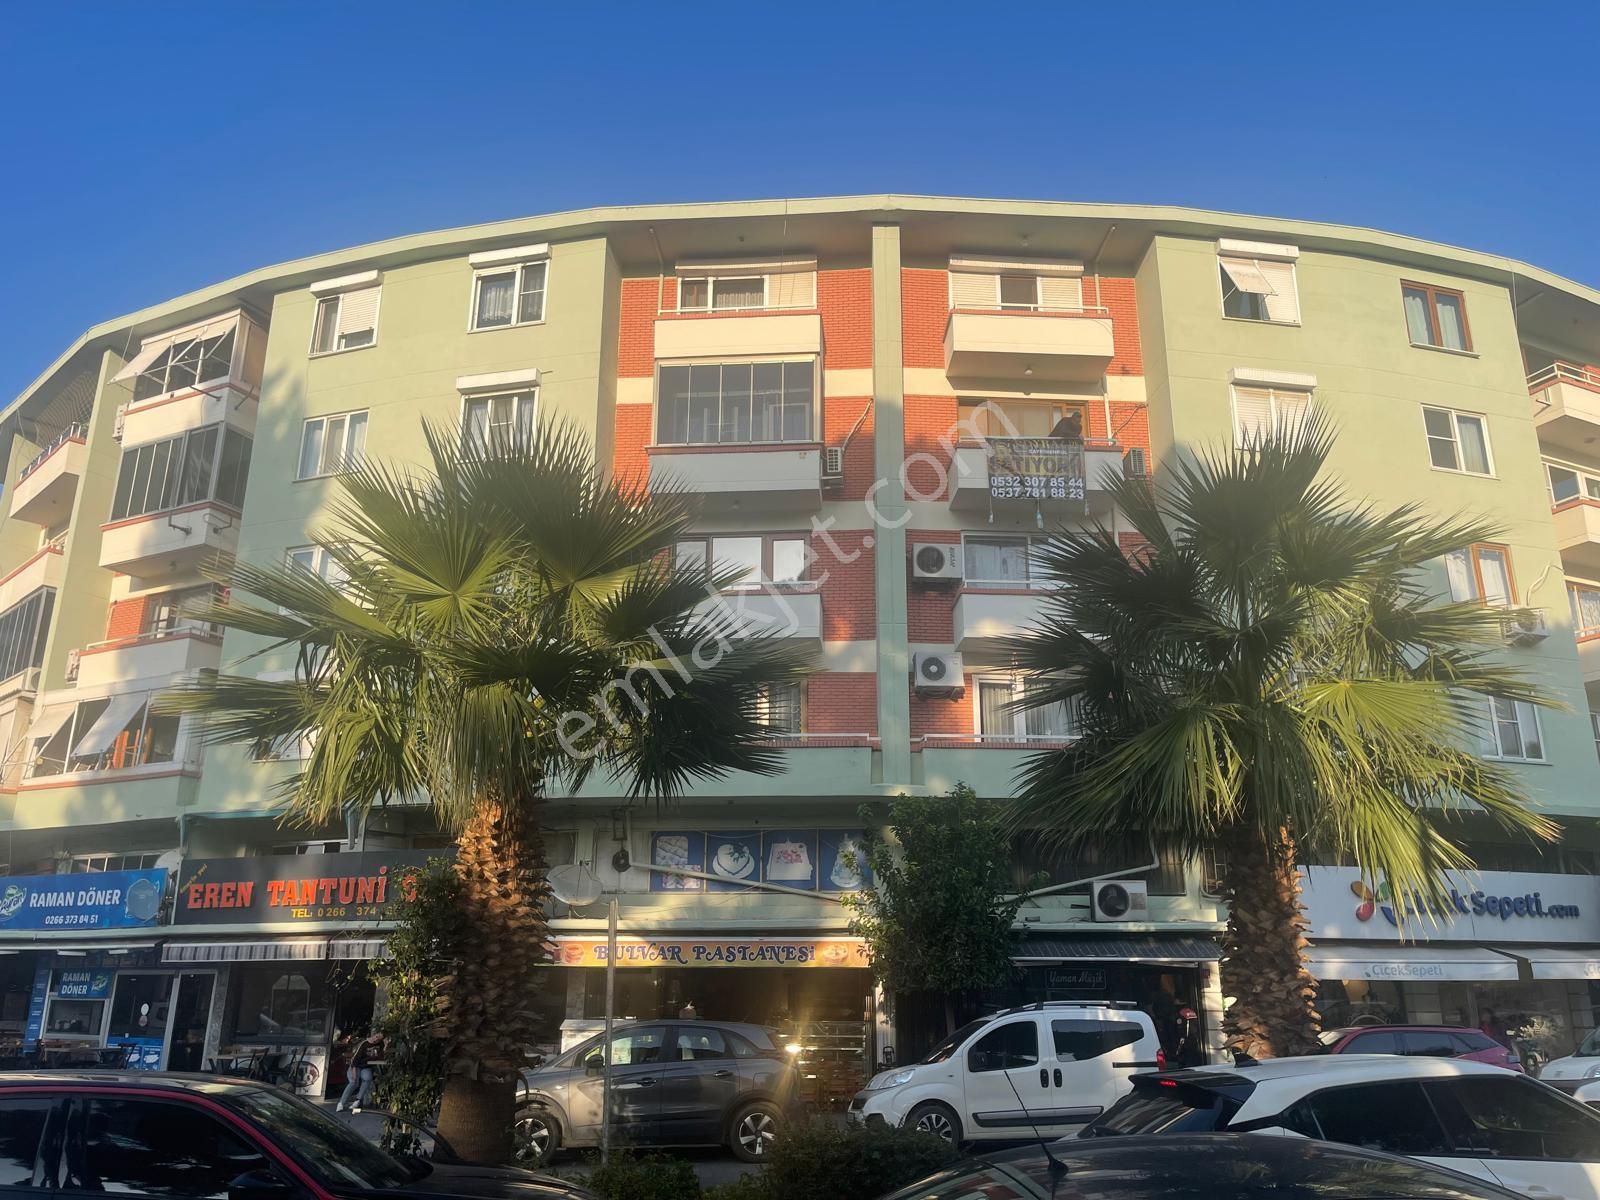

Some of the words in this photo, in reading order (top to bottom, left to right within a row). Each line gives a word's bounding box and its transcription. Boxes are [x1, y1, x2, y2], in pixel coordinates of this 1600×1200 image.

[991, 476, 1020, 487] 0532
[1024, 476, 1047, 487] 307
[1050, 477, 1065, 487] 85
[1068, 478, 1083, 488] 44
[991, 487, 1021, 498] 0537
[1025, 487, 1046, 498] 781
[1069, 488, 1084, 499] 23
[29, 891, 75, 908] RAMAN
[77, 887, 121, 907] DÖNER
[187, 881, 254, 909] EREN
[356, 906, 377, 916] 374
[45, 915, 64, 925] 0266
[65, 915, 78, 924] 373
[79, 915, 89, 924] 84
[90, 914, 98, 923] 51
[593, 942, 688, 964] BULVAR
[62, 972, 91, 982] RAMAN
[61, 982, 88, 995] DÖNER
